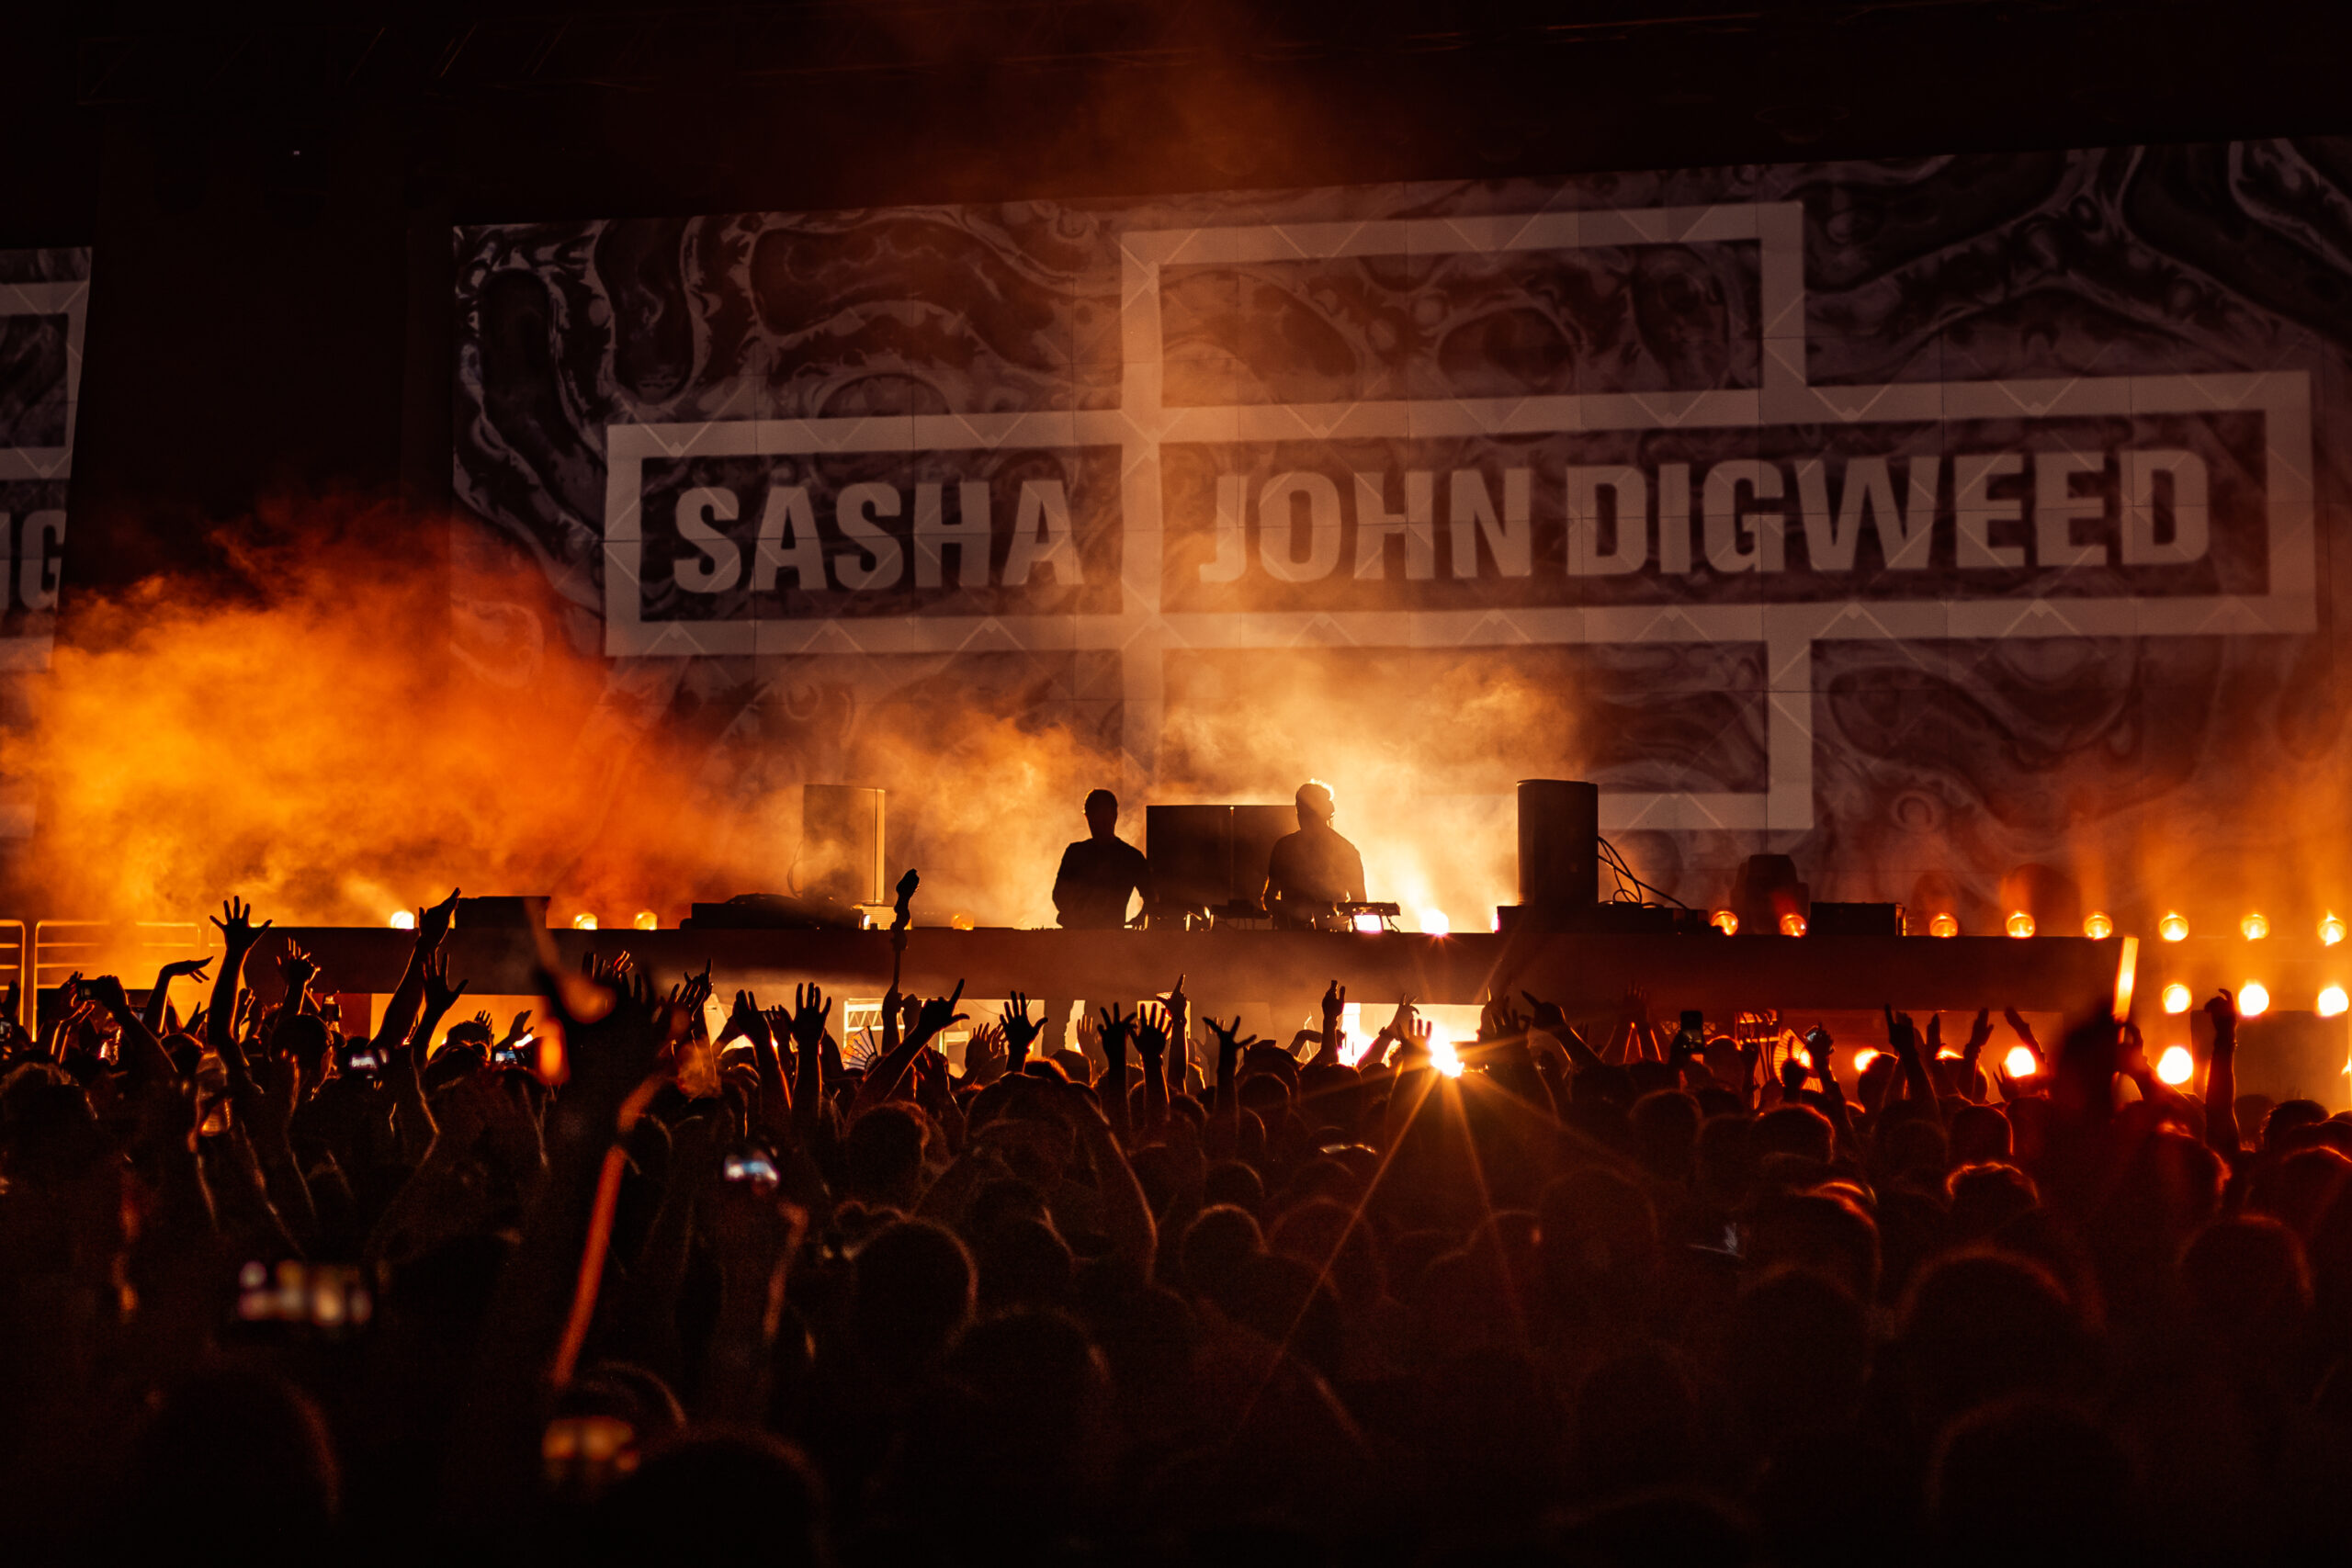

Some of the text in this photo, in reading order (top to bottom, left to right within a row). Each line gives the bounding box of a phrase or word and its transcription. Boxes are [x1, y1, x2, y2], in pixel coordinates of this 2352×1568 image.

[673, 479, 1085, 593] SASHA
[1198, 448, 2211, 583] JOHN DIGWEED
